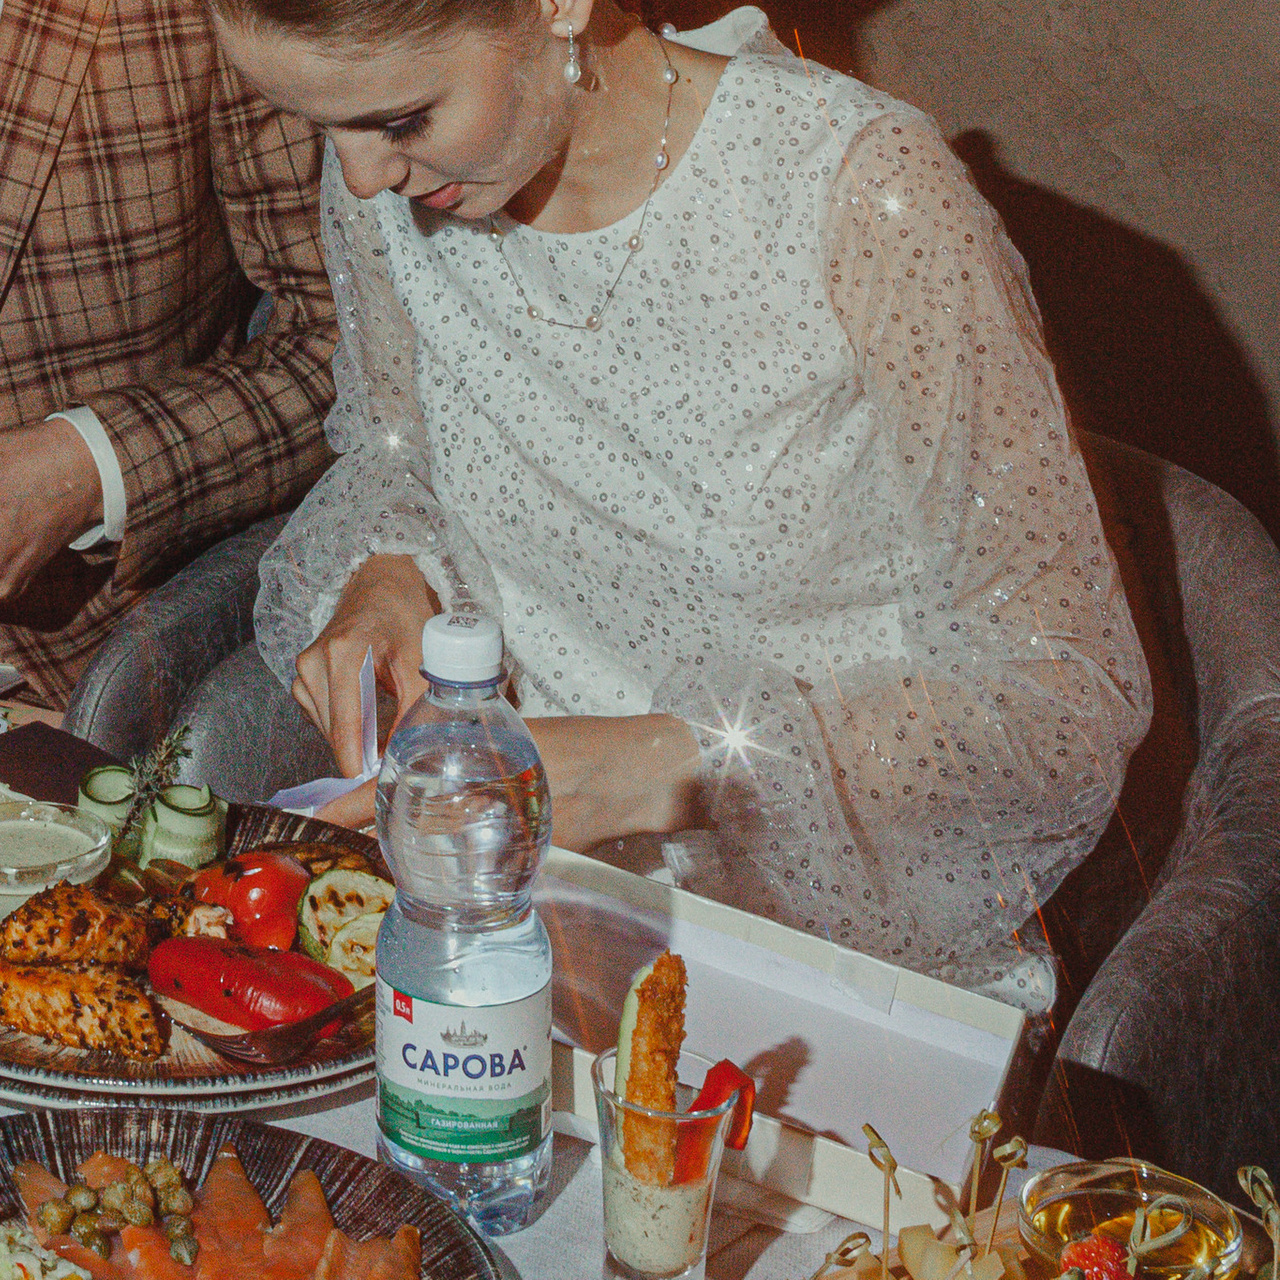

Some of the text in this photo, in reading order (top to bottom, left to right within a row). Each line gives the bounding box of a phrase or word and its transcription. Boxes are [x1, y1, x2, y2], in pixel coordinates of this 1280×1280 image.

[402, 1042, 527, 1080] САРОВА
[417, 1077, 513, 1092] МИНЕРАЛЬНАЯ ВОДА
[431, 1117, 499, 1130] ГАЗИРОВАННАЯ
